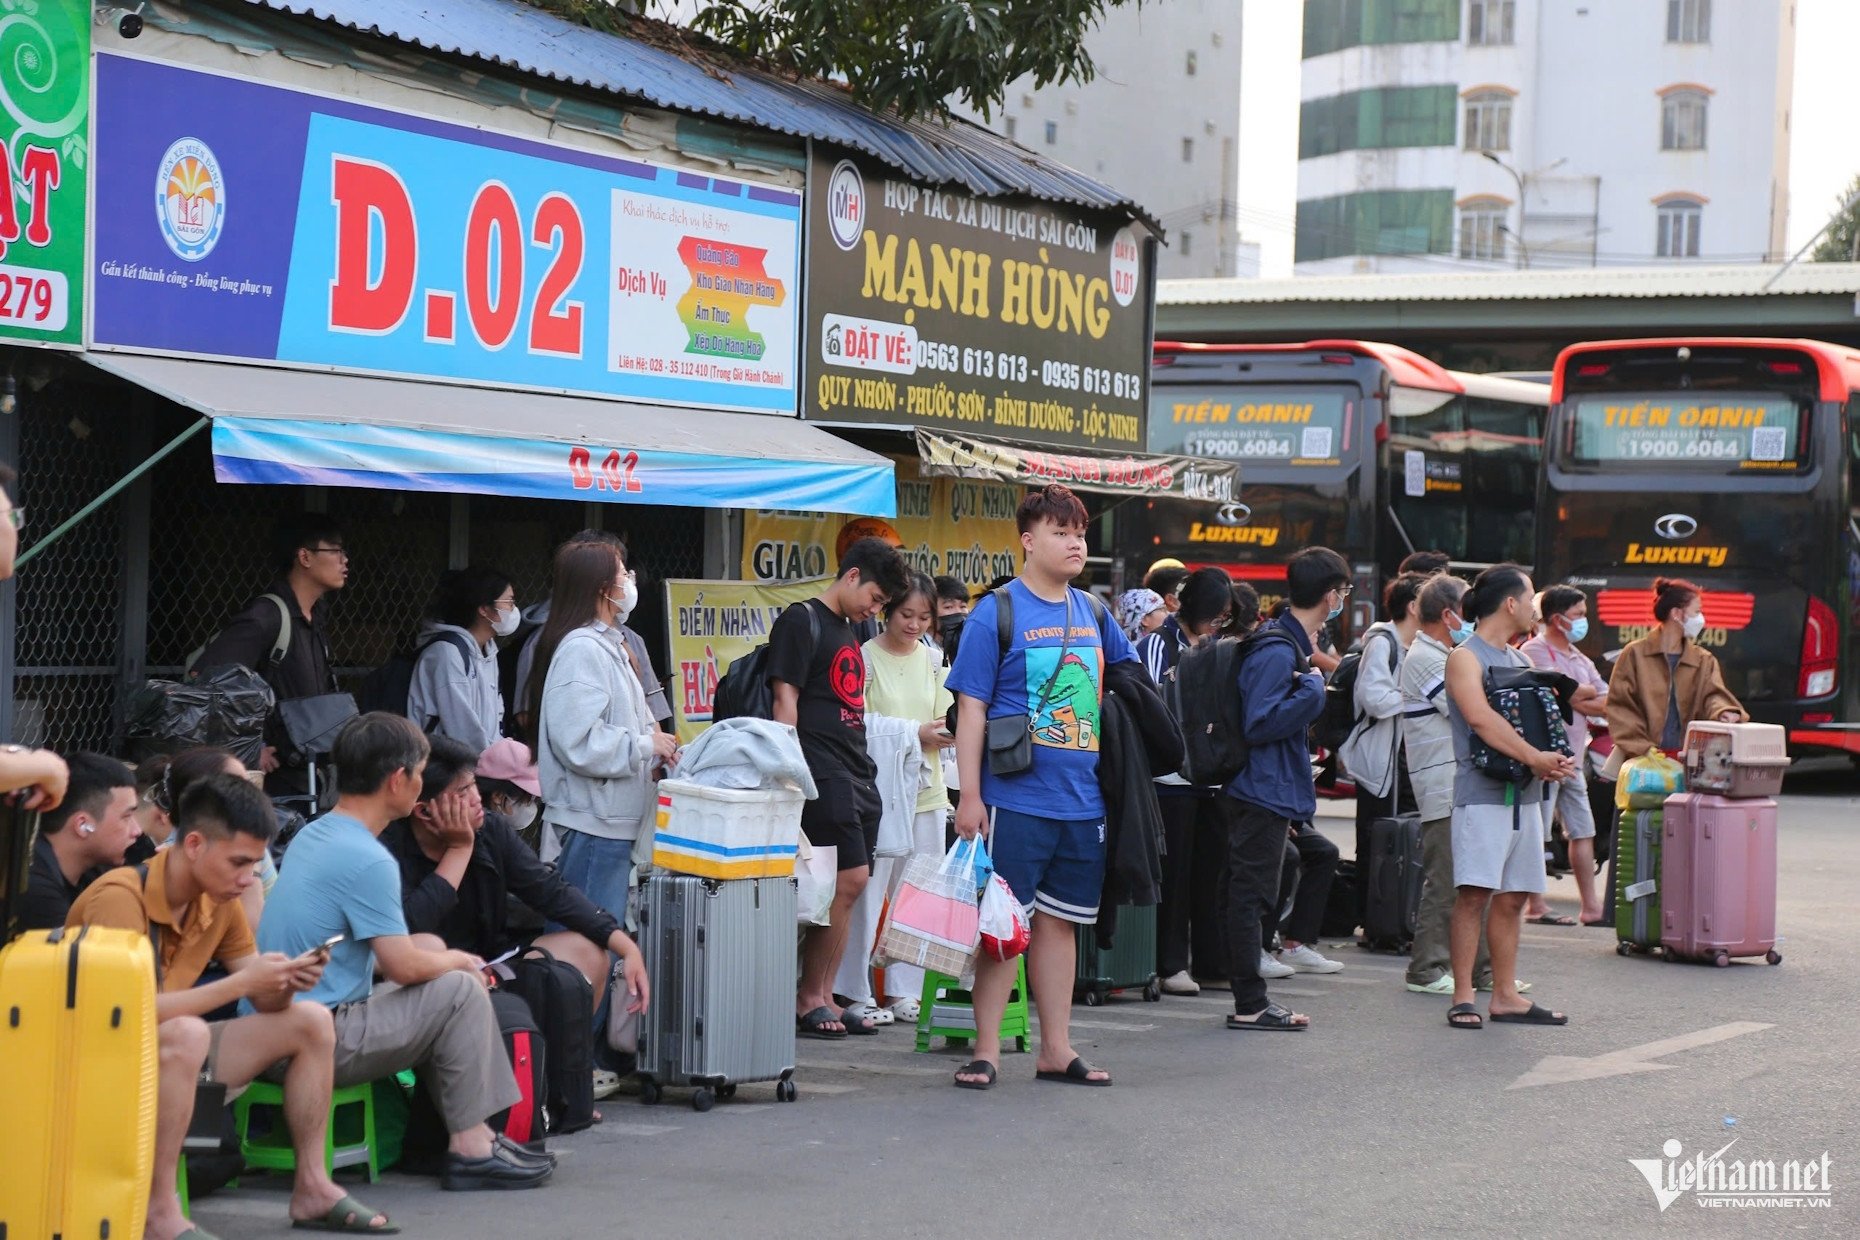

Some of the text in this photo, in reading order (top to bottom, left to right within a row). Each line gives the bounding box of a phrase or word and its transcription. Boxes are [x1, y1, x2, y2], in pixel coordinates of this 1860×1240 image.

[623, 199, 645, 218] Khai
[646, 202, 667, 221] thác
[668, 207, 689, 228] dịch
[690, 217, 700, 231] vụ
[884, 179, 919, 217] HỢP
[922, 183, 954, 221] TÁC
[981, 202, 1001, 232] DU
[1004, 208, 1036, 242] LỊCH
[1039, 213, 1062, 246] SÀI
[1065, 219, 1097, 254] GÒN
[327, 152, 585, 360] D.02
[123, 263, 137, 279] kết
[138, 266, 165, 283] thành
[166, 271, 187, 288] công
[220, 276, 239, 295] lòng
[239, 279, 260, 296] phục
[262, 285, 273, 297] vụ
[619, 267, 667, 301] Dịch Vụ
[696, 272, 712, 289] Kho
[715, 275, 732, 292] Giao
[861, 229, 1111, 340] MẠNH HÙNG
[1115, 269, 1134, 296] D.01
[0, 273, 52, 322] 279
[649, 358, 664, 372] 028
[669, 360, 679, 373] 35
[680, 361, 694, 375] 112
[695, 363, 708, 377] 410
[710, 364, 731, 382] (Trong
[844, 325, 880, 365] ĐẶT
[885, 331, 912, 365] VÉ:
[917, 339, 959, 372] 0563
[963, 347, 994, 378] 613
[997, 352, 1028, 383] 613
[1042, 359, 1080, 391] 0935
[1083, 366, 1111, 396] 613
[1113, 371, 1141, 400] 613
[818, 374, 851, 411] QUY
[854, 377, 897, 412] NHƠN
[906, 381, 955, 419] PHƯỚC
[957, 389, 986, 422] SƠN
[994, 390, 1028, 427] BÌNH
[1029, 398, 1075, 433] DƯƠNG
[1082, 402, 1107, 444] LỘC
[1108, 413, 1139, 442] NINH
[1236, 403, 1315, 424] OANH
[1678, 406, 1767, 428] OANH
[1195, 439, 1290, 456] 1900.6084
[1629, 439, 1738, 457] 1900.6084
[568, 446, 643, 493] D.02
[951, 481, 978, 522] QUY
[1188, 522, 1280, 547] Luxury
[753, 541, 826, 580] GIAO
[1624, 542, 1728, 568] Luxury
[679, 592, 716, 636] ĐIỂM
[720, 600, 767, 642] NHẬN
[1024, 626, 1064, 642] LEVENTS
